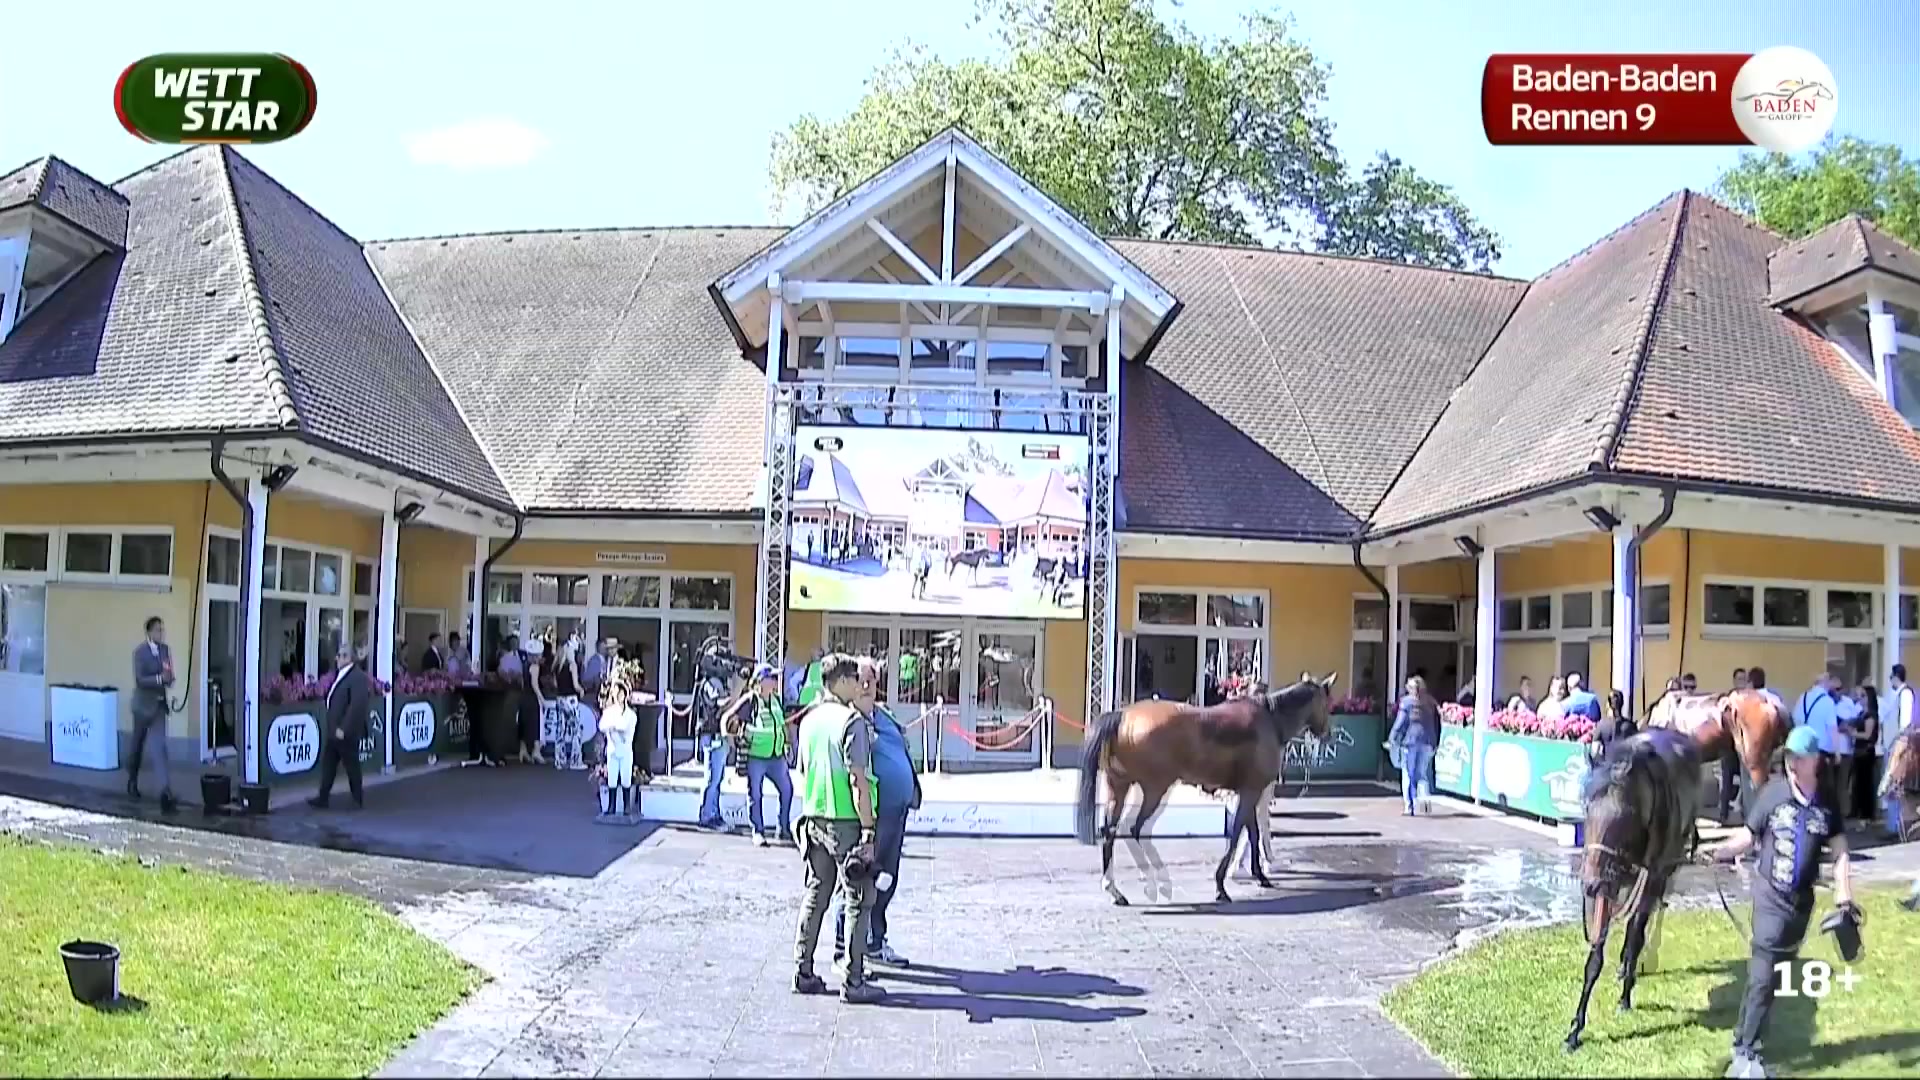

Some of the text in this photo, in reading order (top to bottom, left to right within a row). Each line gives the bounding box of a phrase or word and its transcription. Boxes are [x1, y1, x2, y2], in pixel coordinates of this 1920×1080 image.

[405, 709, 426, 728] WETT
[277, 723, 306, 745] WETT
[411, 725, 429, 744] STAR
[286, 743, 311, 764] STAR
